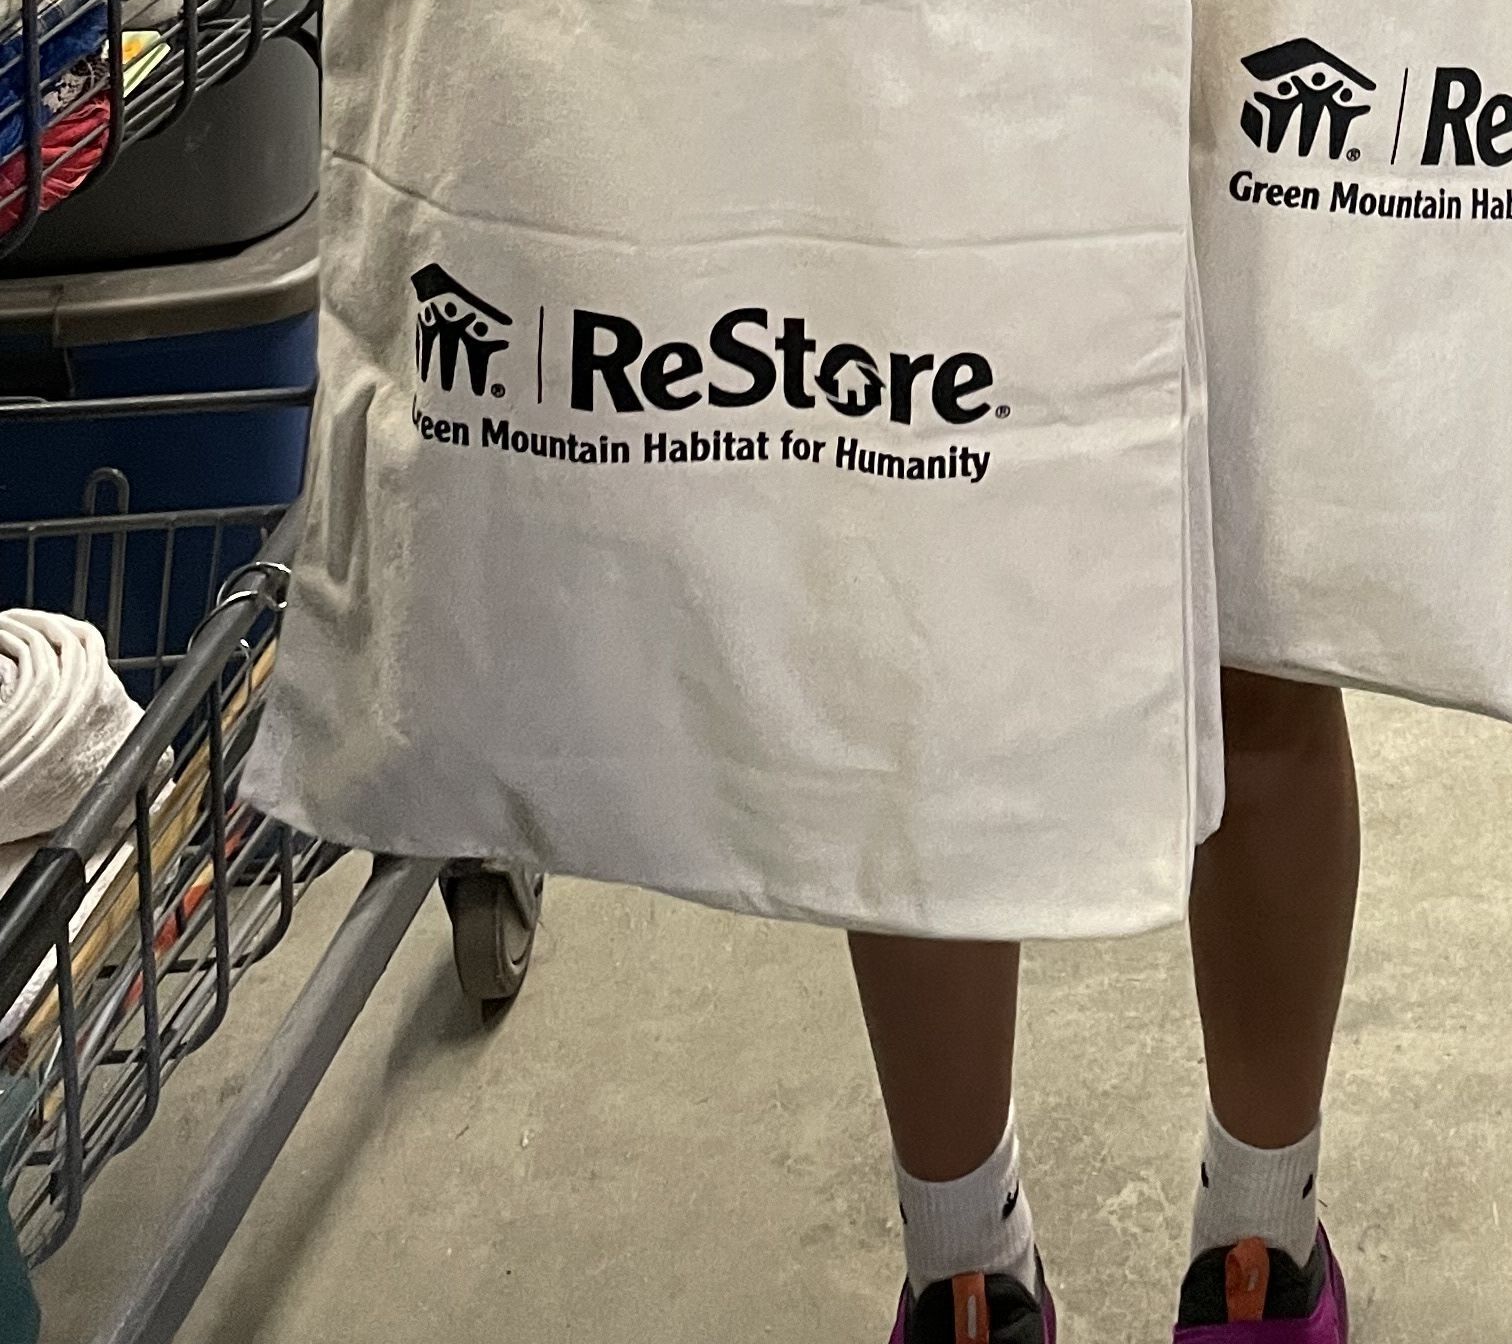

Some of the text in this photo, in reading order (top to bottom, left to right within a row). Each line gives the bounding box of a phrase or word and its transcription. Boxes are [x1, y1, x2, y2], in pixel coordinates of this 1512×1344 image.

[1229, 169, 1320, 211] Green
[1330, 181, 1461, 221] Mountain
[570, 307, 994, 426] ReStore
[481, 418, 631, 464] Mountain
[643, 429, 770, 464] Habitat
[780, 430, 828, 464] for
[834, 435, 992, 484] Humanity
